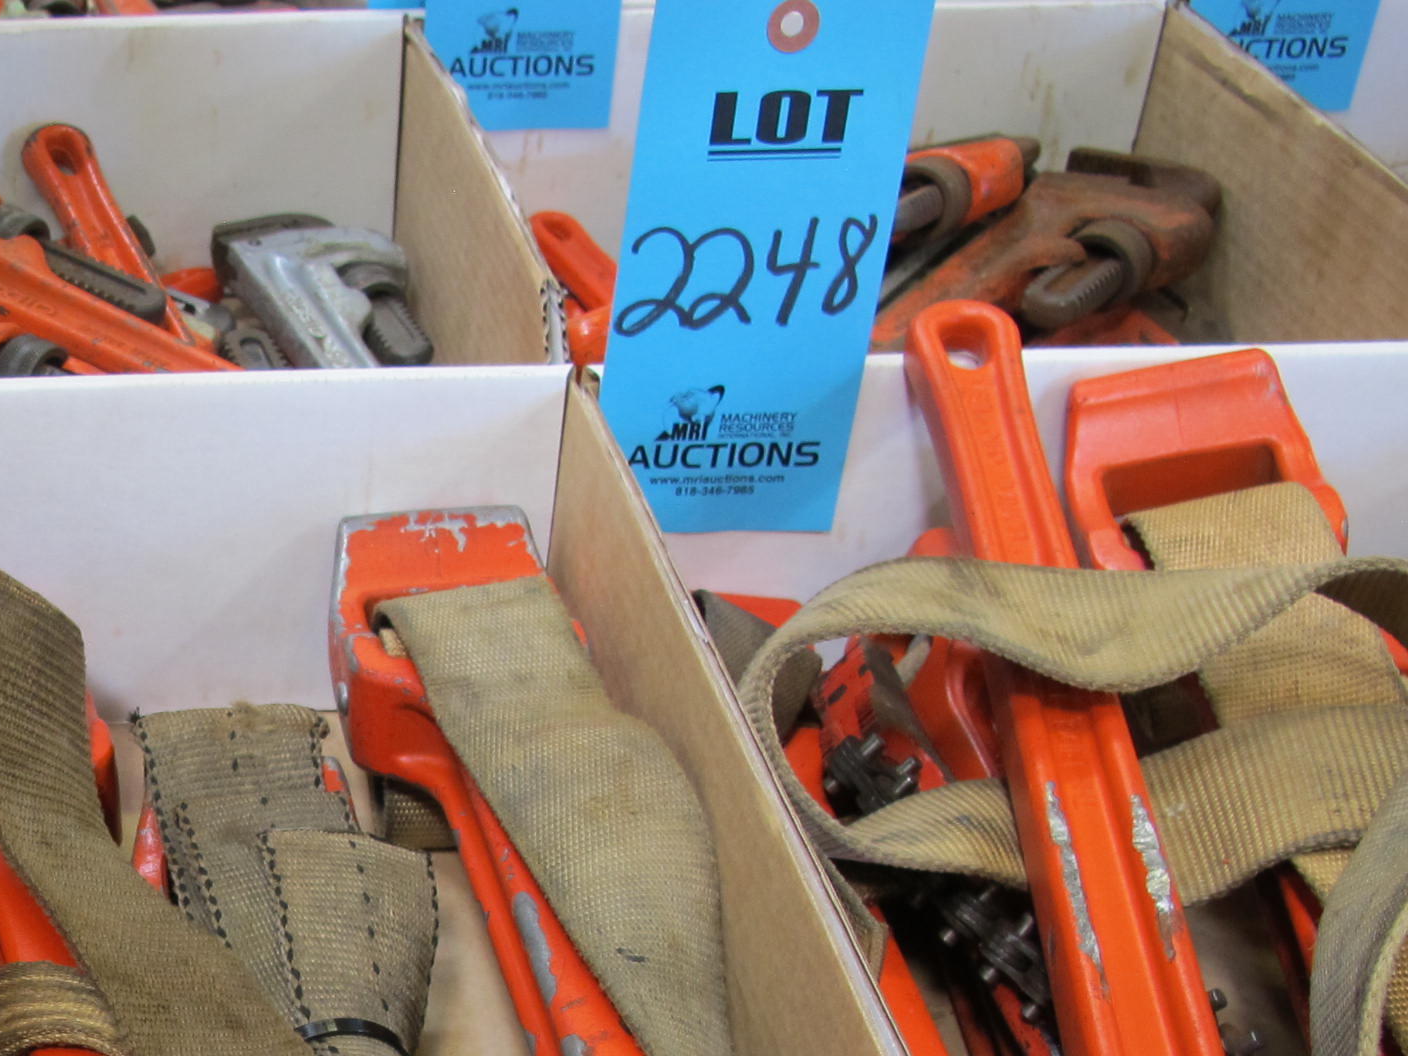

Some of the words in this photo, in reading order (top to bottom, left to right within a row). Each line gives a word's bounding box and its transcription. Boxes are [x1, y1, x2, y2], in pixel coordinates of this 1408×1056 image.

[1239, 35, 1349, 59] CTIONS
[450, 54, 595, 78] AUCTIONS
[709, 88, 864, 147] LOT
[613, 214, 878, 337] 2248
[719, 422, 795, 433] RESOURCES
[720, 412, 798, 424] MACHINERY
[671, 420, 710, 441] MRI
[628, 441, 821, 469] AUCTIONS
[650, 474, 785, 486] www.mriauctions.com
